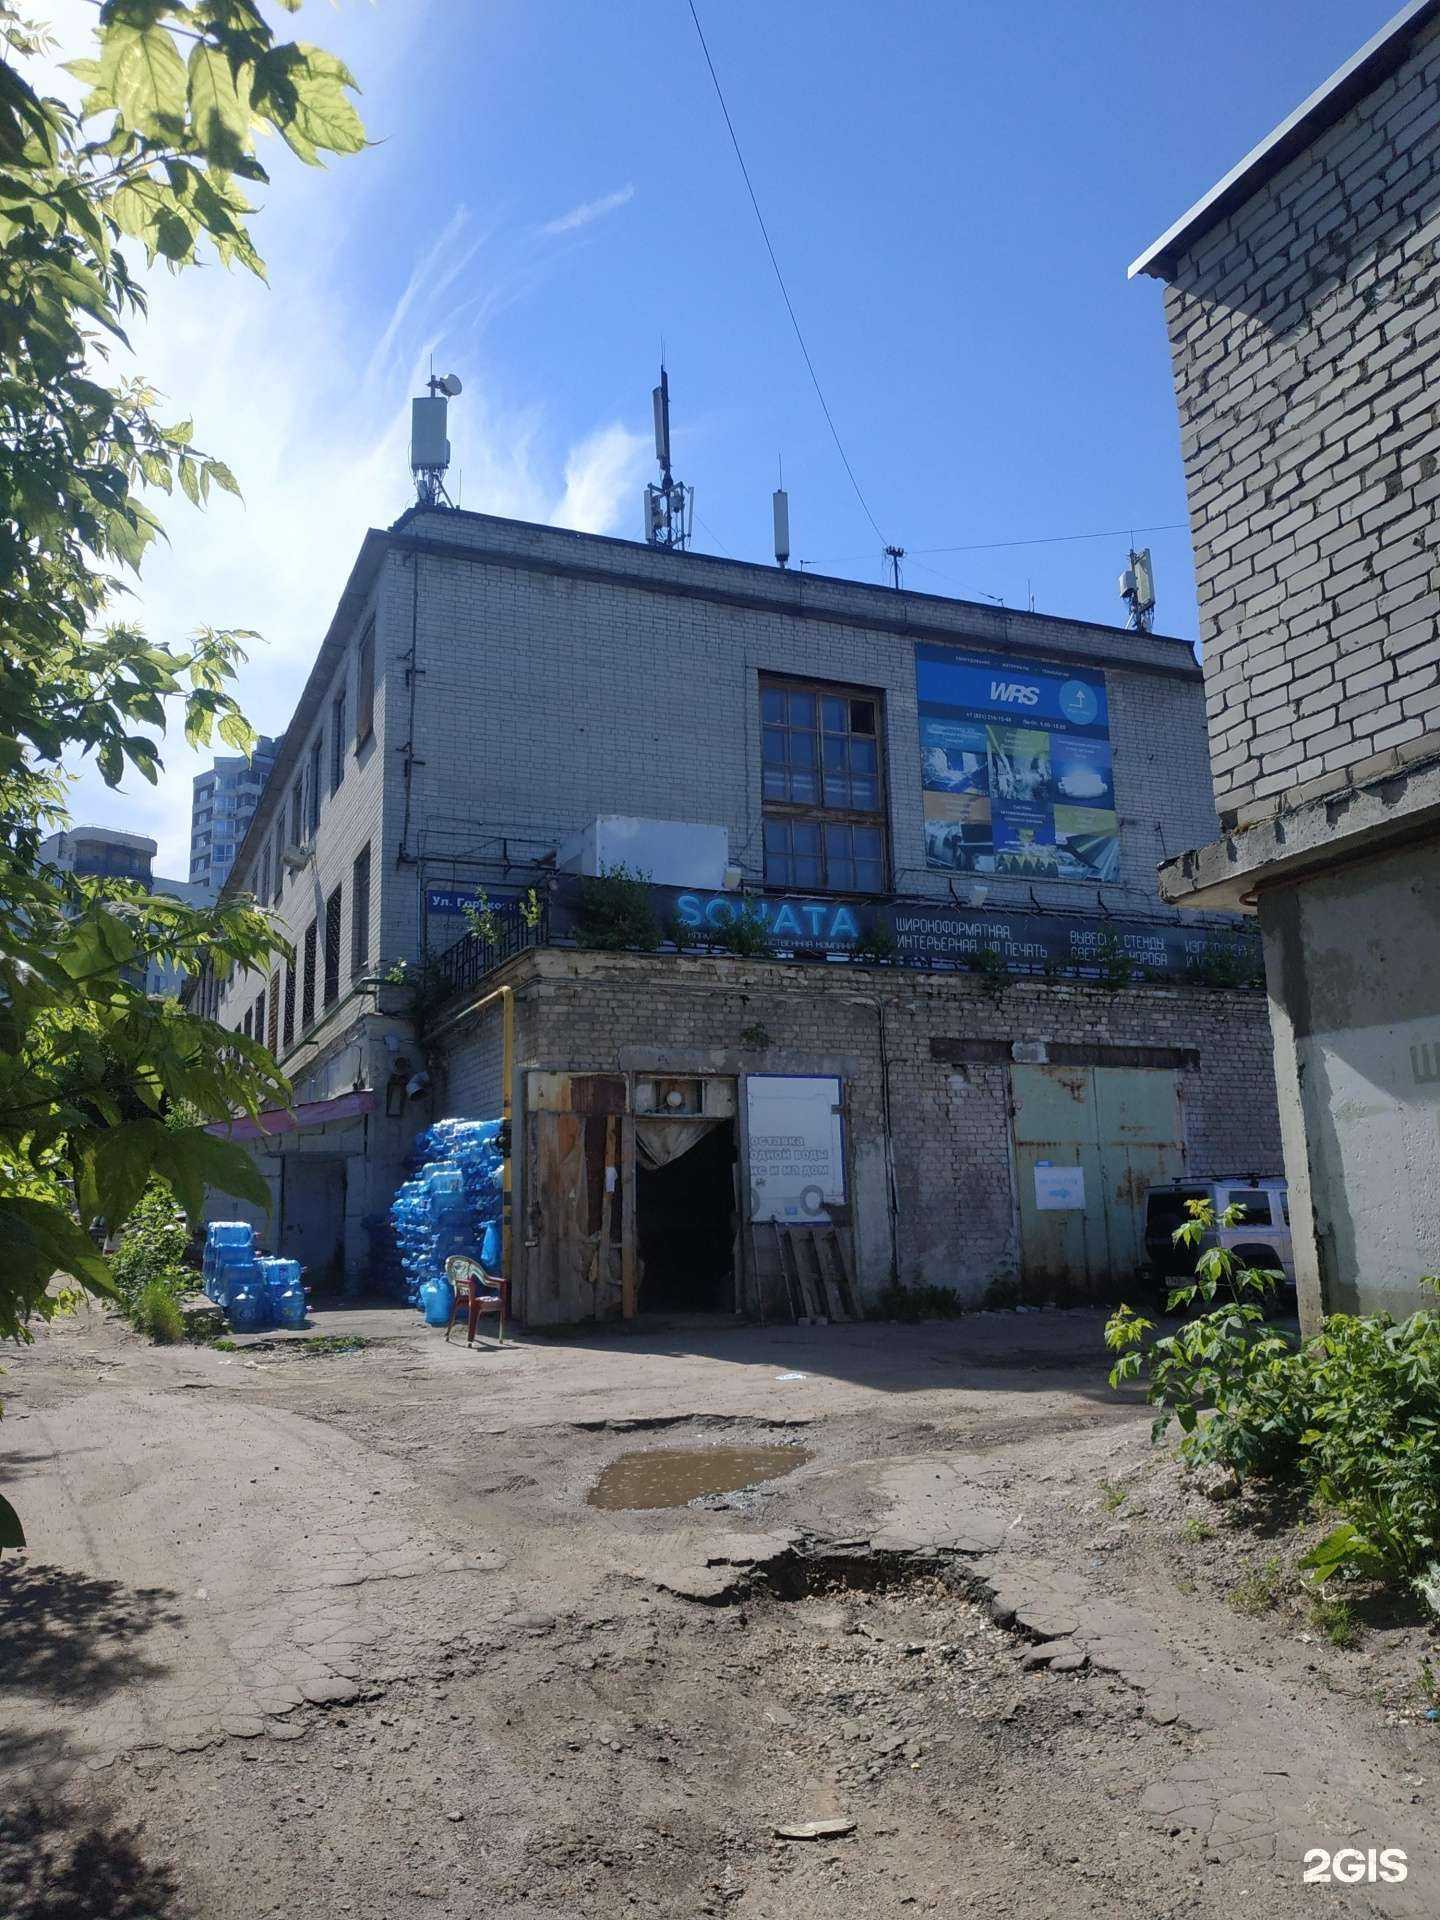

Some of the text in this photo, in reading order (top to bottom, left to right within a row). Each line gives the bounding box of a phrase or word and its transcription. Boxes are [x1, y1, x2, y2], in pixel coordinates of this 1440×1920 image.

[990, 681, 1040, 705] WRS
[432, 895, 453, 906] Ул.
[456, 897, 512, 911] Горко
[1004, 941, 1048, 959] ПЕЧАТЬ
[1070, 945, 1168, 966] СВЕТОЕ КОРОБА
[801, 1164, 829, 1177] дом
